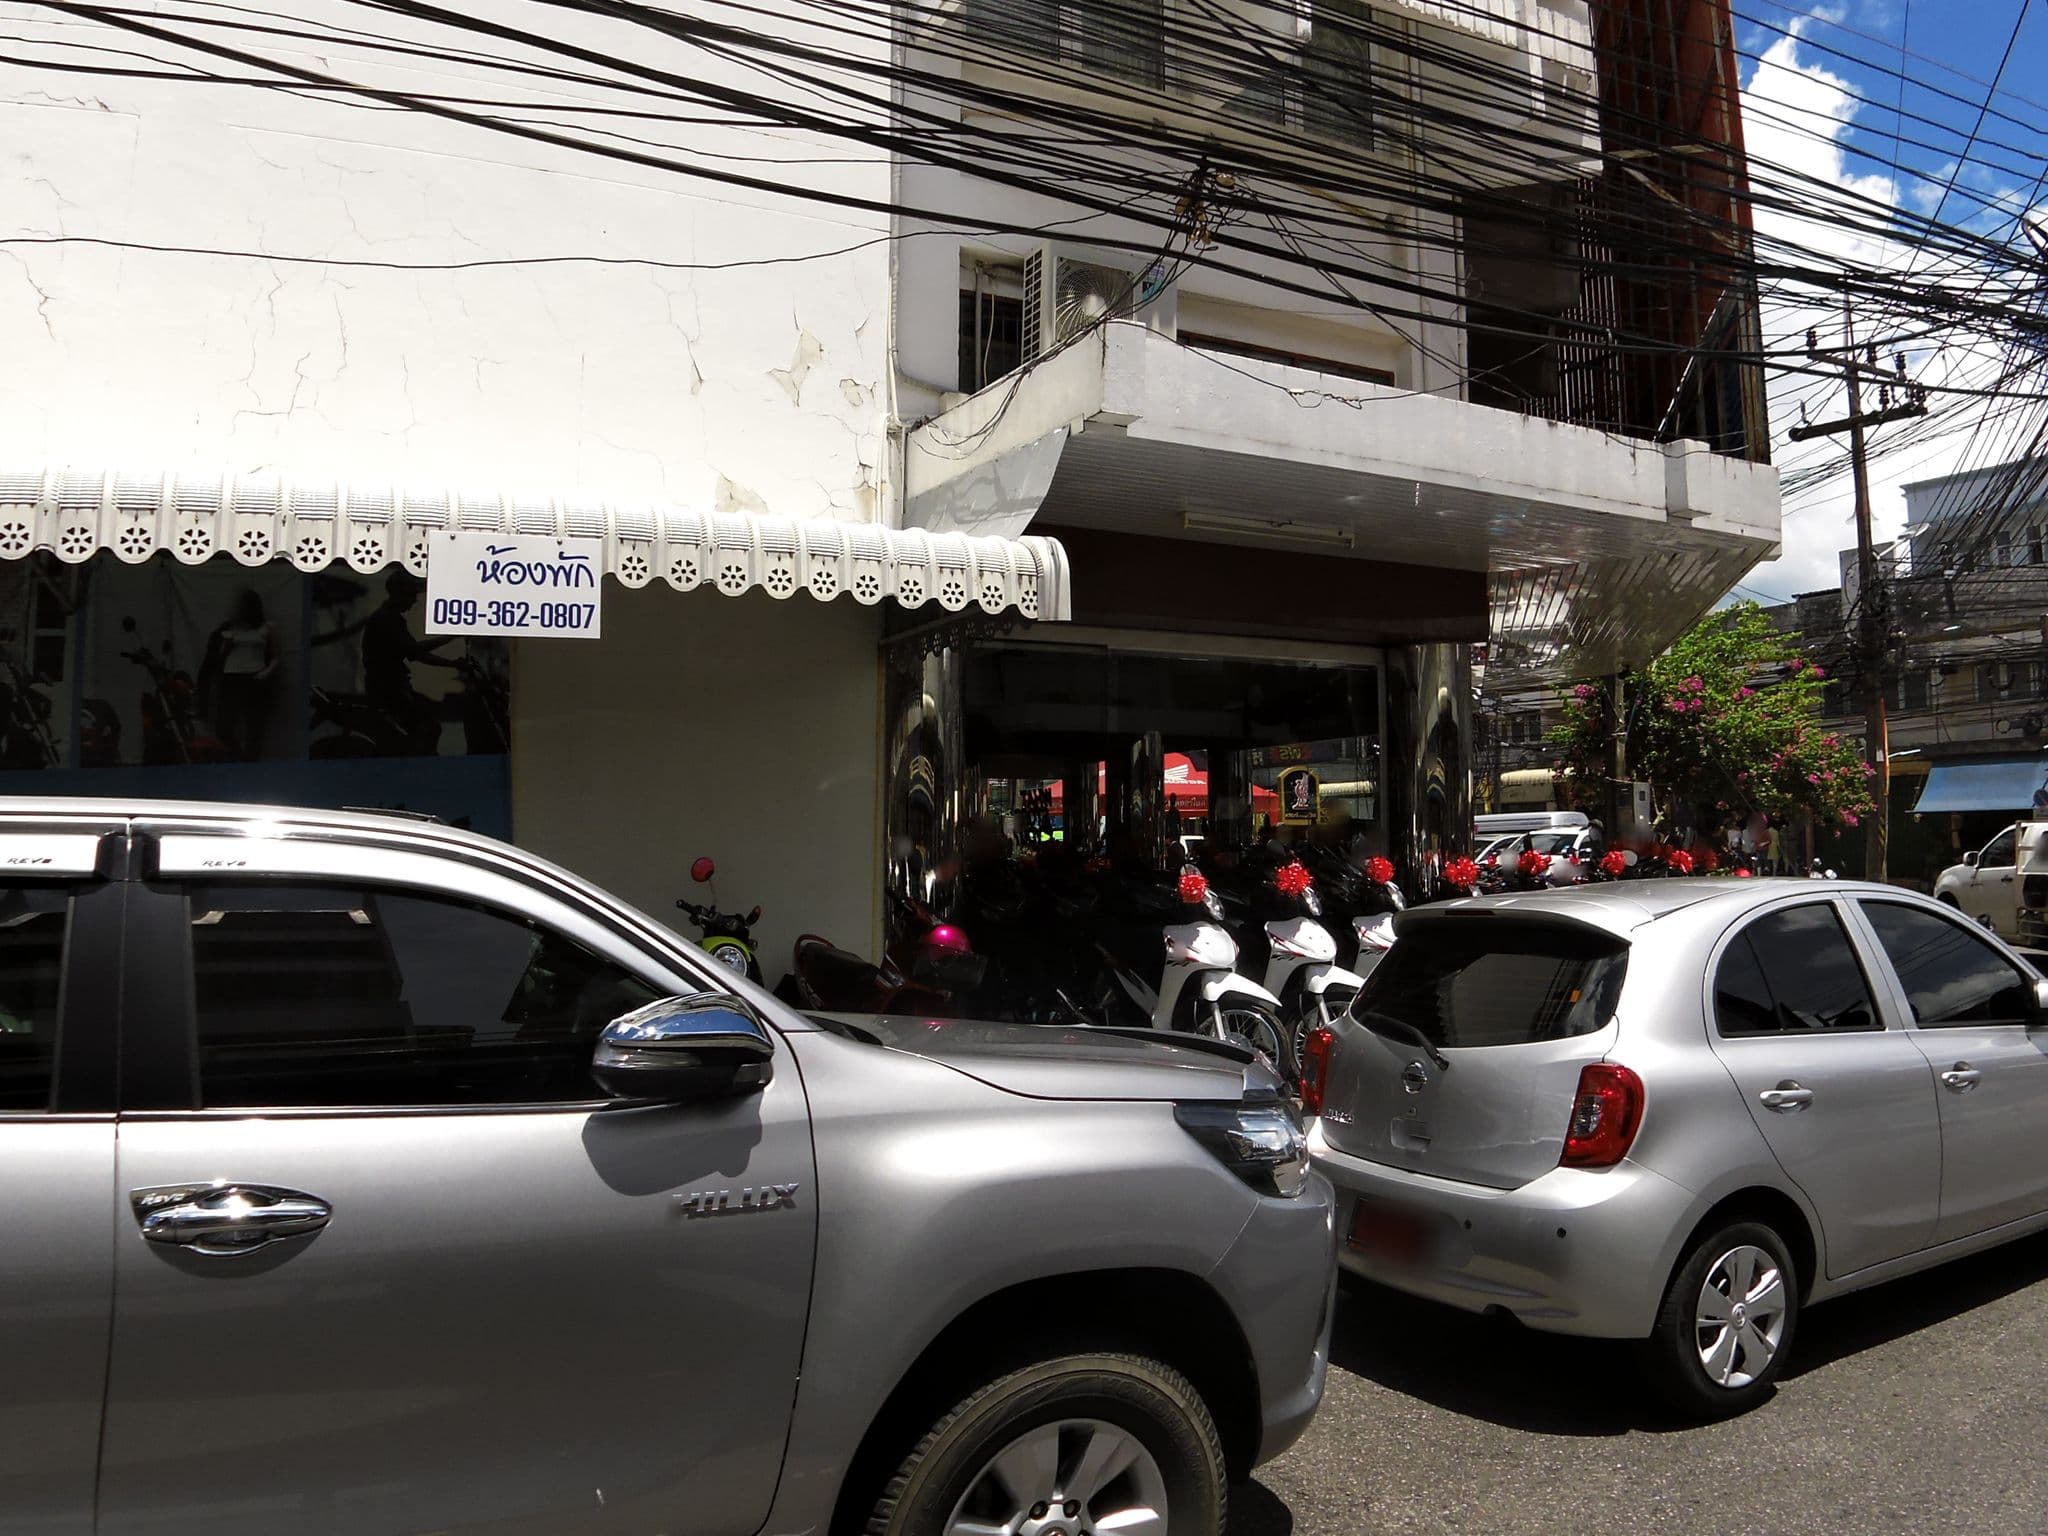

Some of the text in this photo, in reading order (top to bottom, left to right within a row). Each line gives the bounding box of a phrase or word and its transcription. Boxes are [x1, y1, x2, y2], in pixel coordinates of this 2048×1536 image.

[476, 544, 595, 588] ห้องพัก
[433, 598, 596, 630] 099-362-0807
